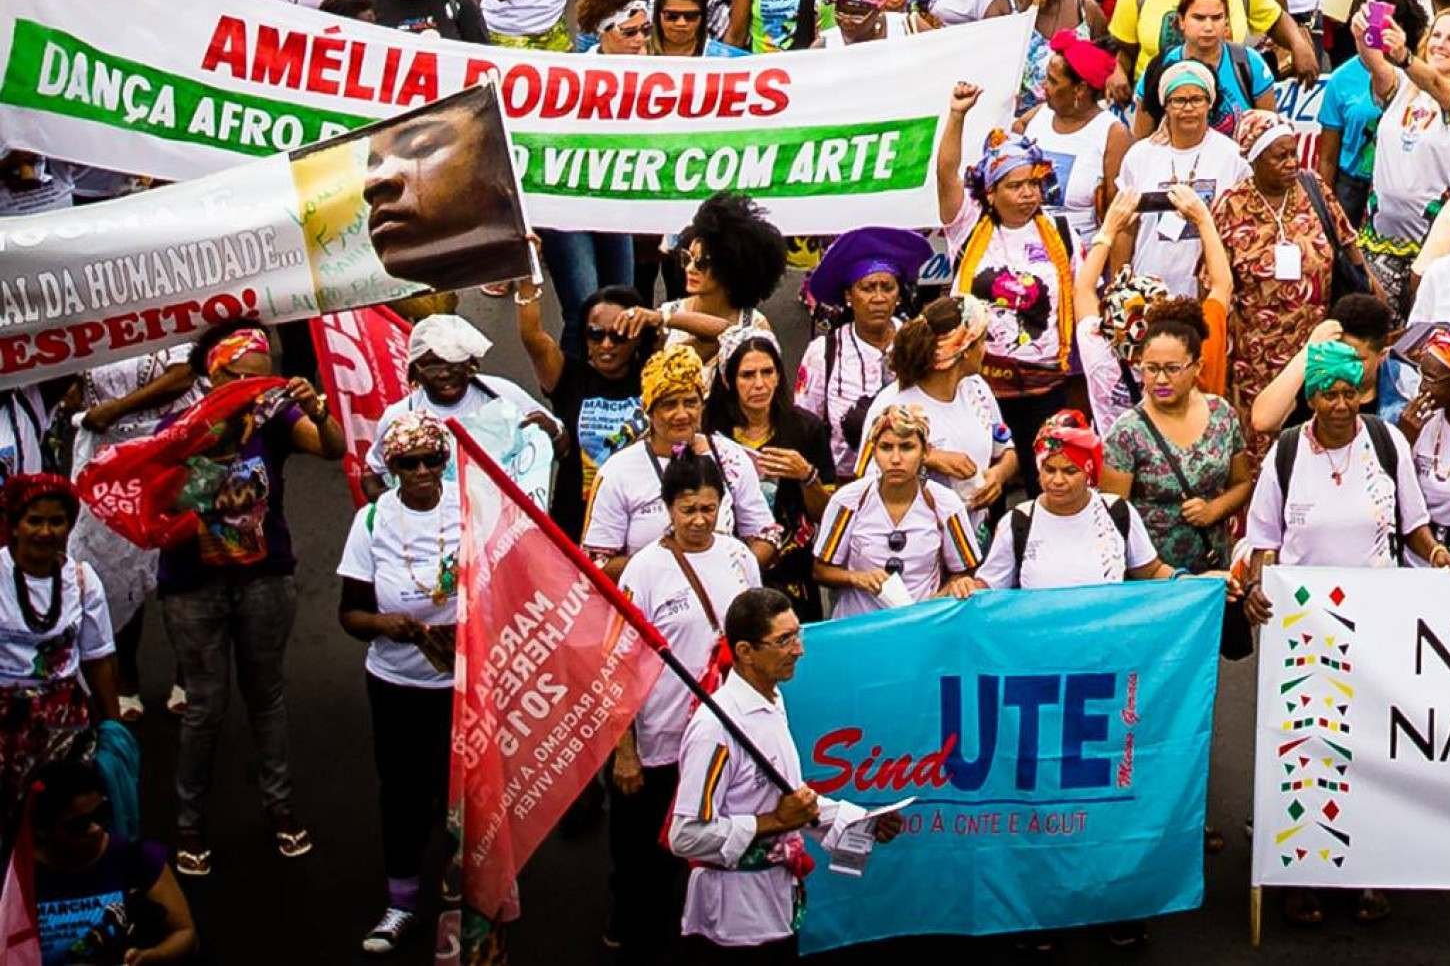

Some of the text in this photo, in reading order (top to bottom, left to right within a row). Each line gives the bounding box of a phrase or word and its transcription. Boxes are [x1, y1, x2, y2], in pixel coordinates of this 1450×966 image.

[201, 13, 439, 106] AMÉLIA
[37, 40, 303, 151] DANÇA AFRO
[543, 131, 901, 194] VIVER COM ARTE
[39, 274, 83, 319] DA
[92, 478, 142, 500] DAS
[1006, 810, 1017, 834] E
